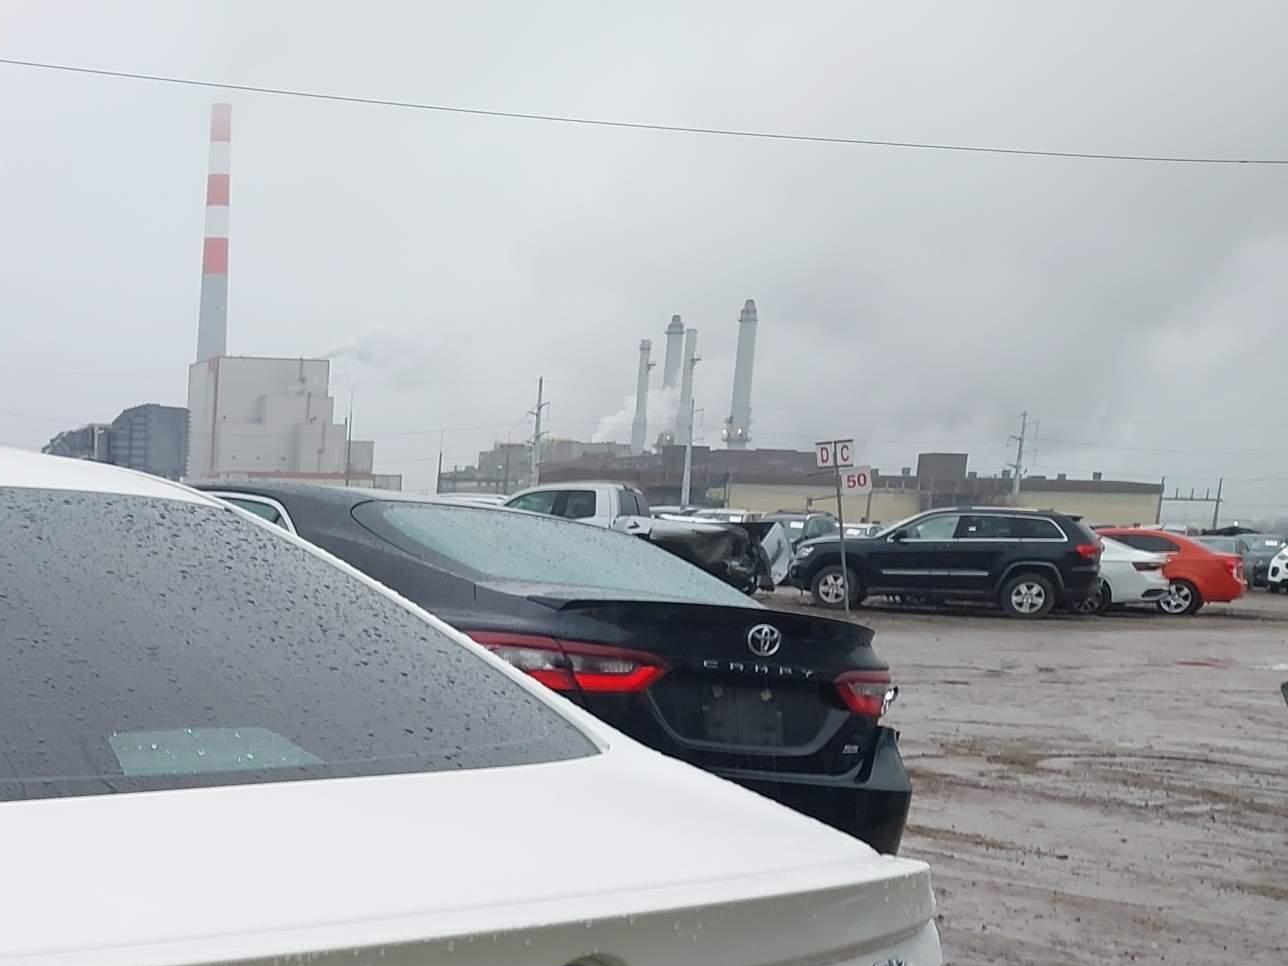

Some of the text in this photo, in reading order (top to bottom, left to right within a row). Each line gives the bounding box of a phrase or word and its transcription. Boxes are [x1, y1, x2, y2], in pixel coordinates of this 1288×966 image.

[820, 444, 850, 463] D C
[847, 473, 868, 489] 50
[703, 659, 813, 678] CAMRY
